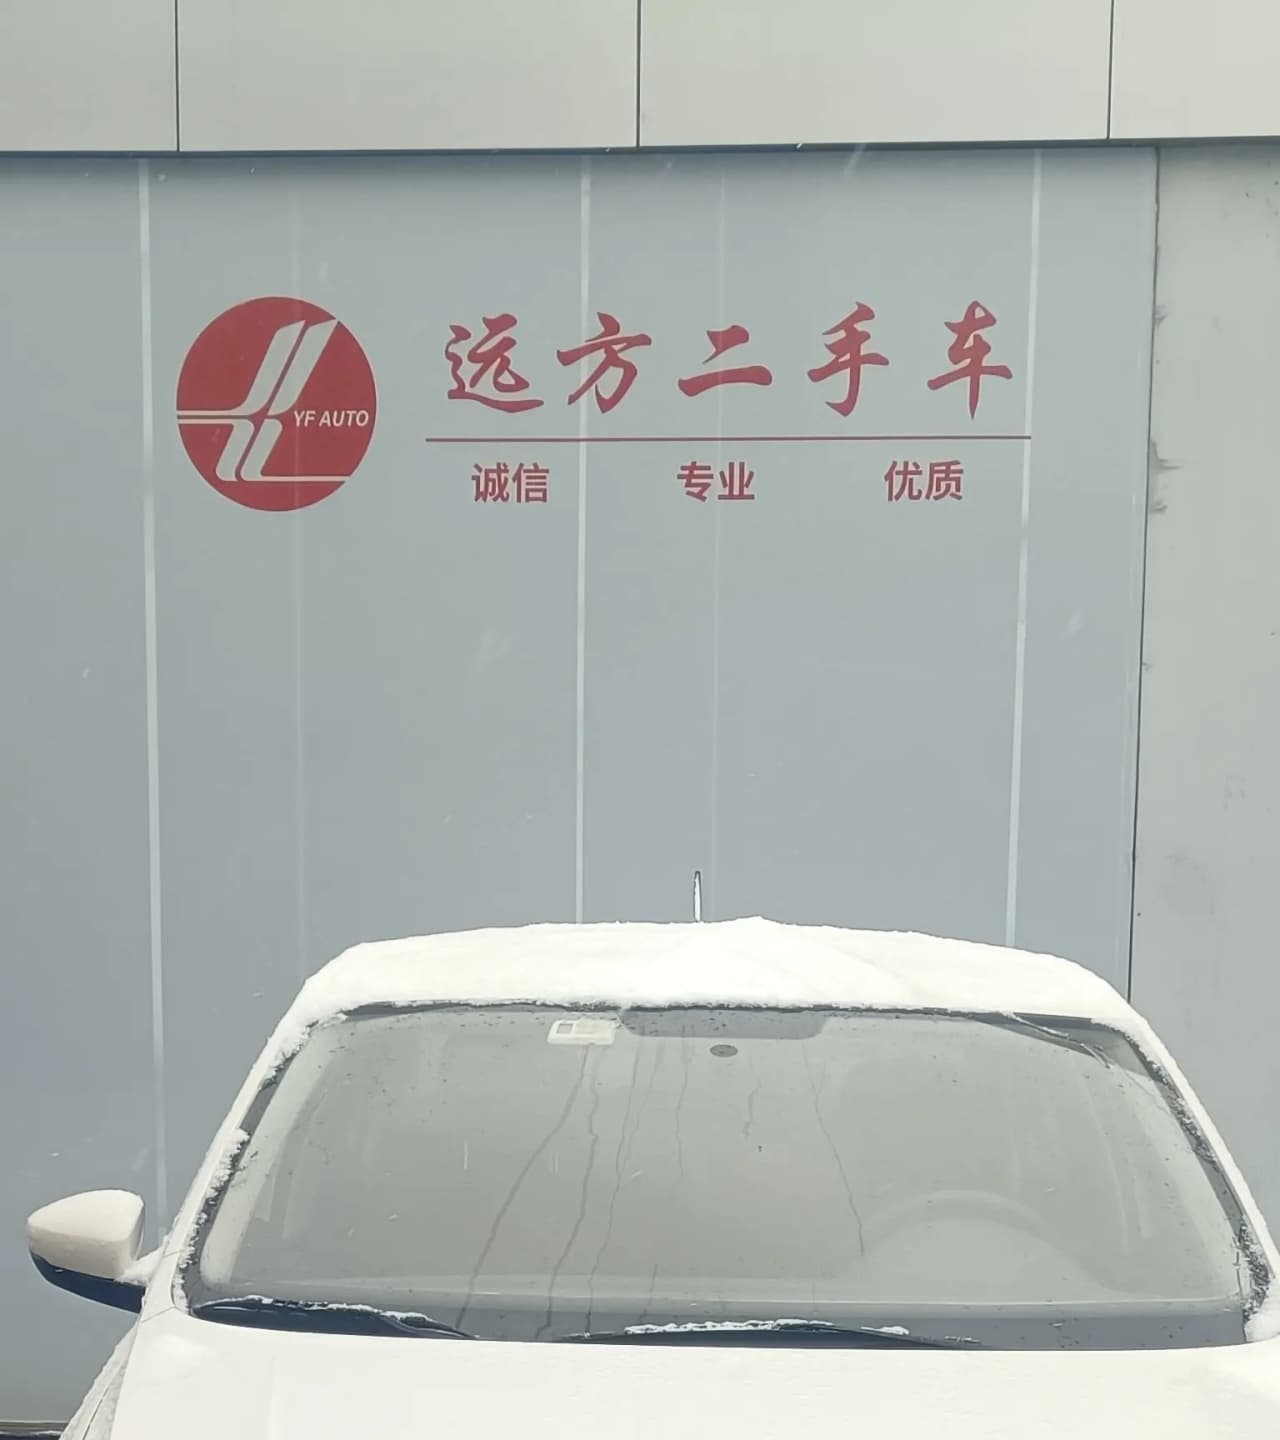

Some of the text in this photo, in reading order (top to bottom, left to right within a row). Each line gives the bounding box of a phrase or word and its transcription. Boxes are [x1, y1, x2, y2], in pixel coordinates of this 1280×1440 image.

[444, 300, 1013, 420] 远方二手车
[294, 409, 369, 427] YF AUTO
[471, 459, 964, 504] 诚信 专业 优质
